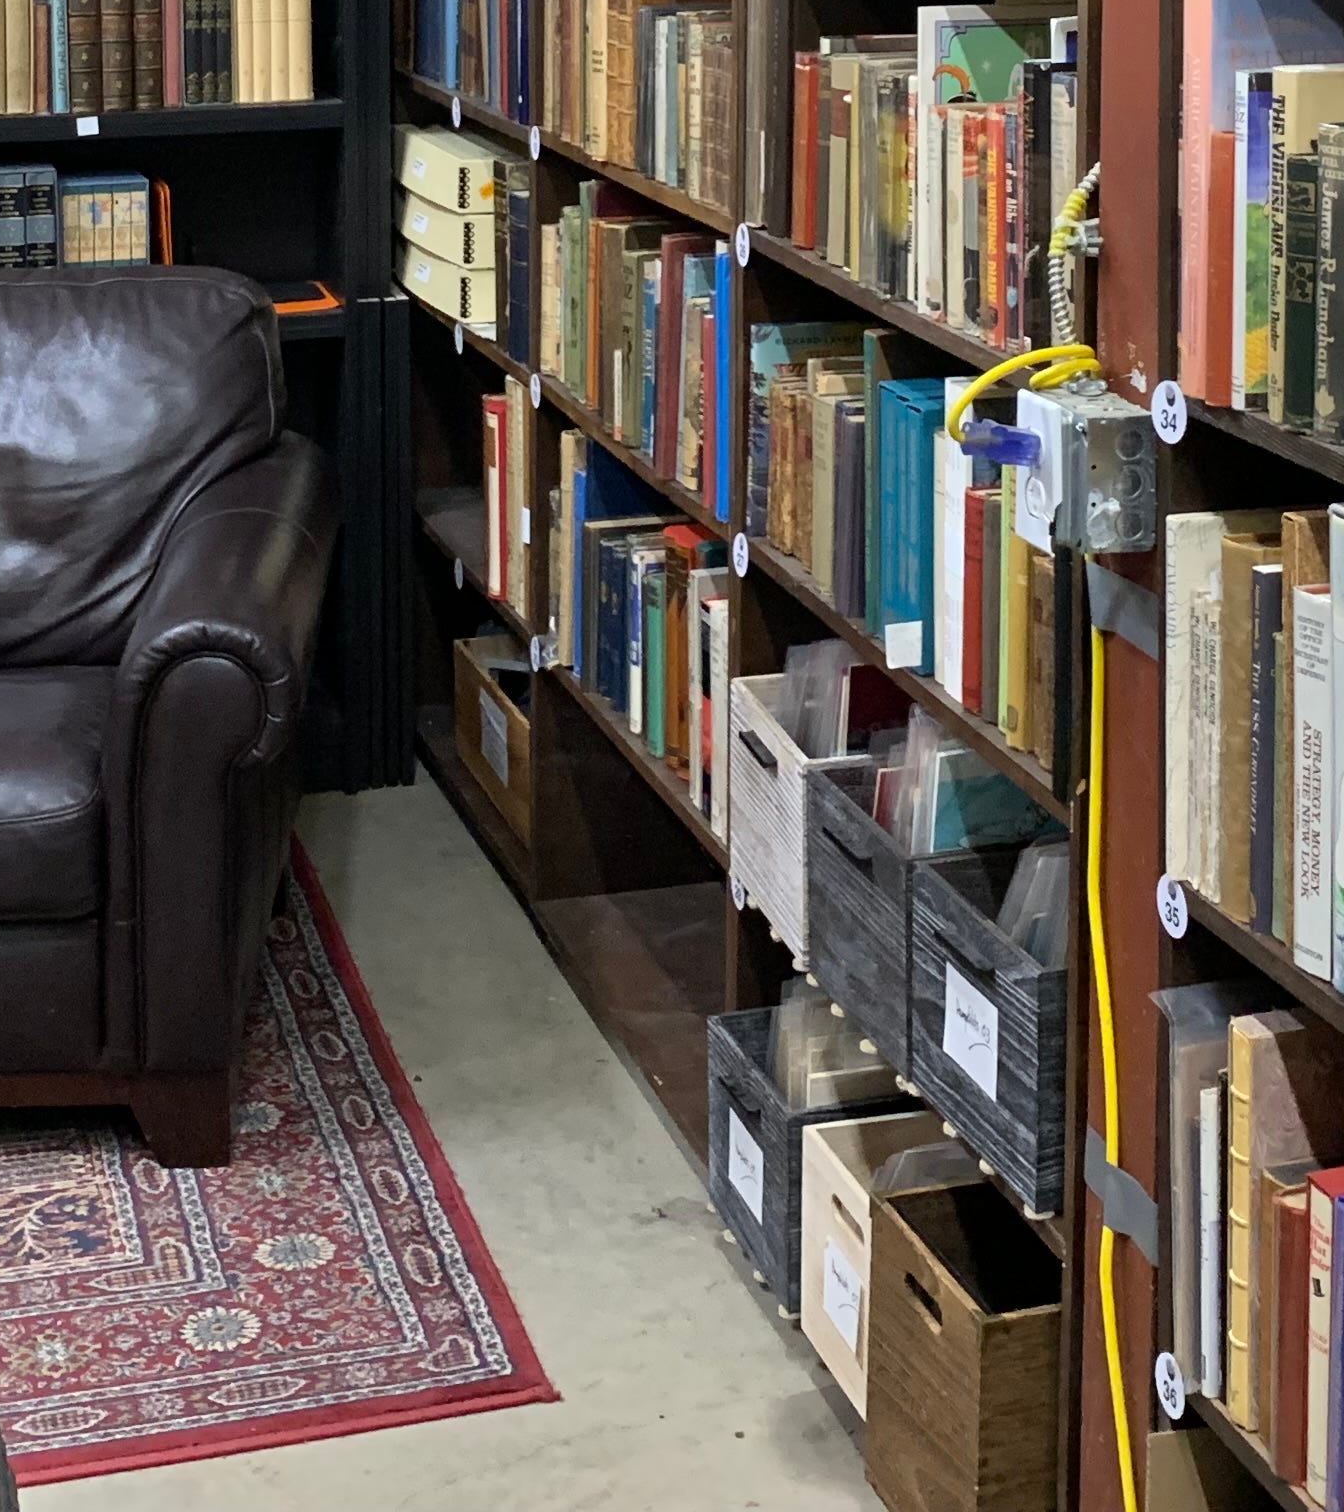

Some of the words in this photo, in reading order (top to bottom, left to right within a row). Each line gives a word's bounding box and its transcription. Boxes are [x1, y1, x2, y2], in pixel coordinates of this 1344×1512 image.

[1270, 94, 1286, 135] THE
[1320, 182, 1339, 251] James
[1315, 282, 1336, 380] Langham
[1159, 409, 1178, 434] 34
[1300, 719, 1313, 760] AND
[1300, 763, 1313, 801] THE
[1308, 728, 1323, 824] STRATEGY,
[1299, 804, 1312, 847] NEW
[1299, 849, 1312, 900] LOOK
[1164, 902, 1182, 930] 35
[1160, 1380, 1178, 1410] 36
